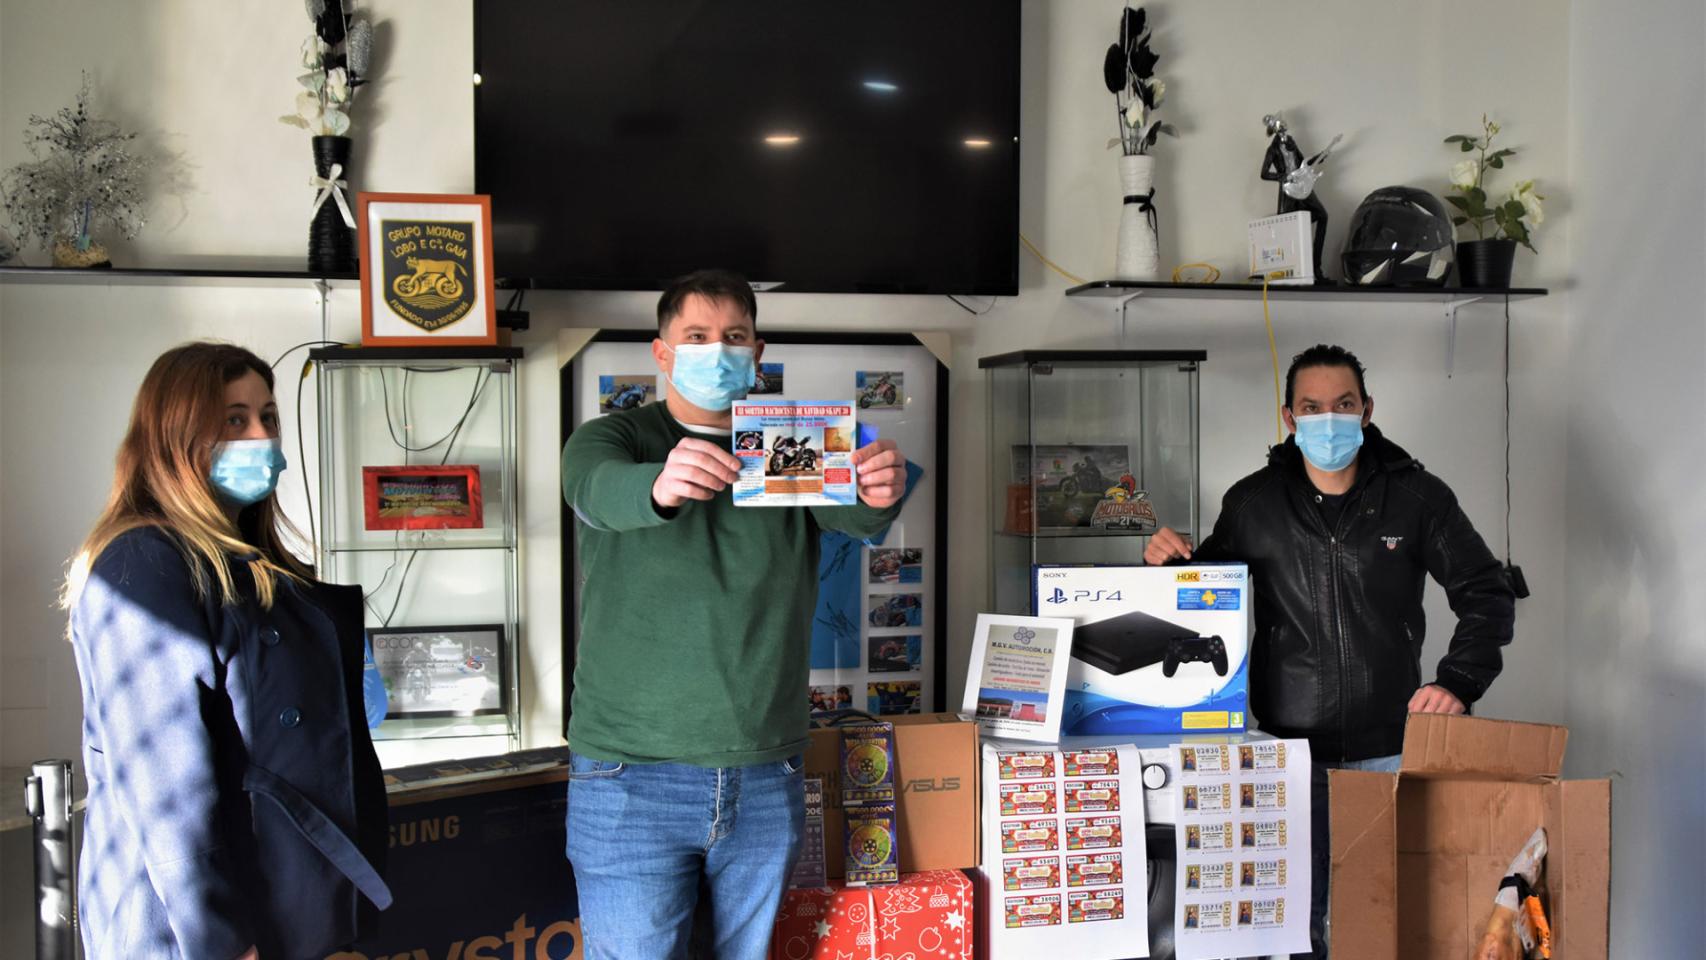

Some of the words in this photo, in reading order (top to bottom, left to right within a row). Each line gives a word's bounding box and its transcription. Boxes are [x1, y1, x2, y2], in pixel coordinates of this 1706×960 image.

[388, 226, 421, 242] GRUPO
[426, 225, 465, 242] MOTARD
[391, 241, 417, 258] LOBO
[446, 242, 467, 259] GAIA
[744, 406, 764, 416] SORTEO
[765, 406, 796, 416] MACROCESTA
[804, 406, 825, 416] NAVIDAD
[1177, 573, 1198, 581] HDR
[1074, 589, 1123, 602] PS4
[903, 777, 961, 793] ASUS
